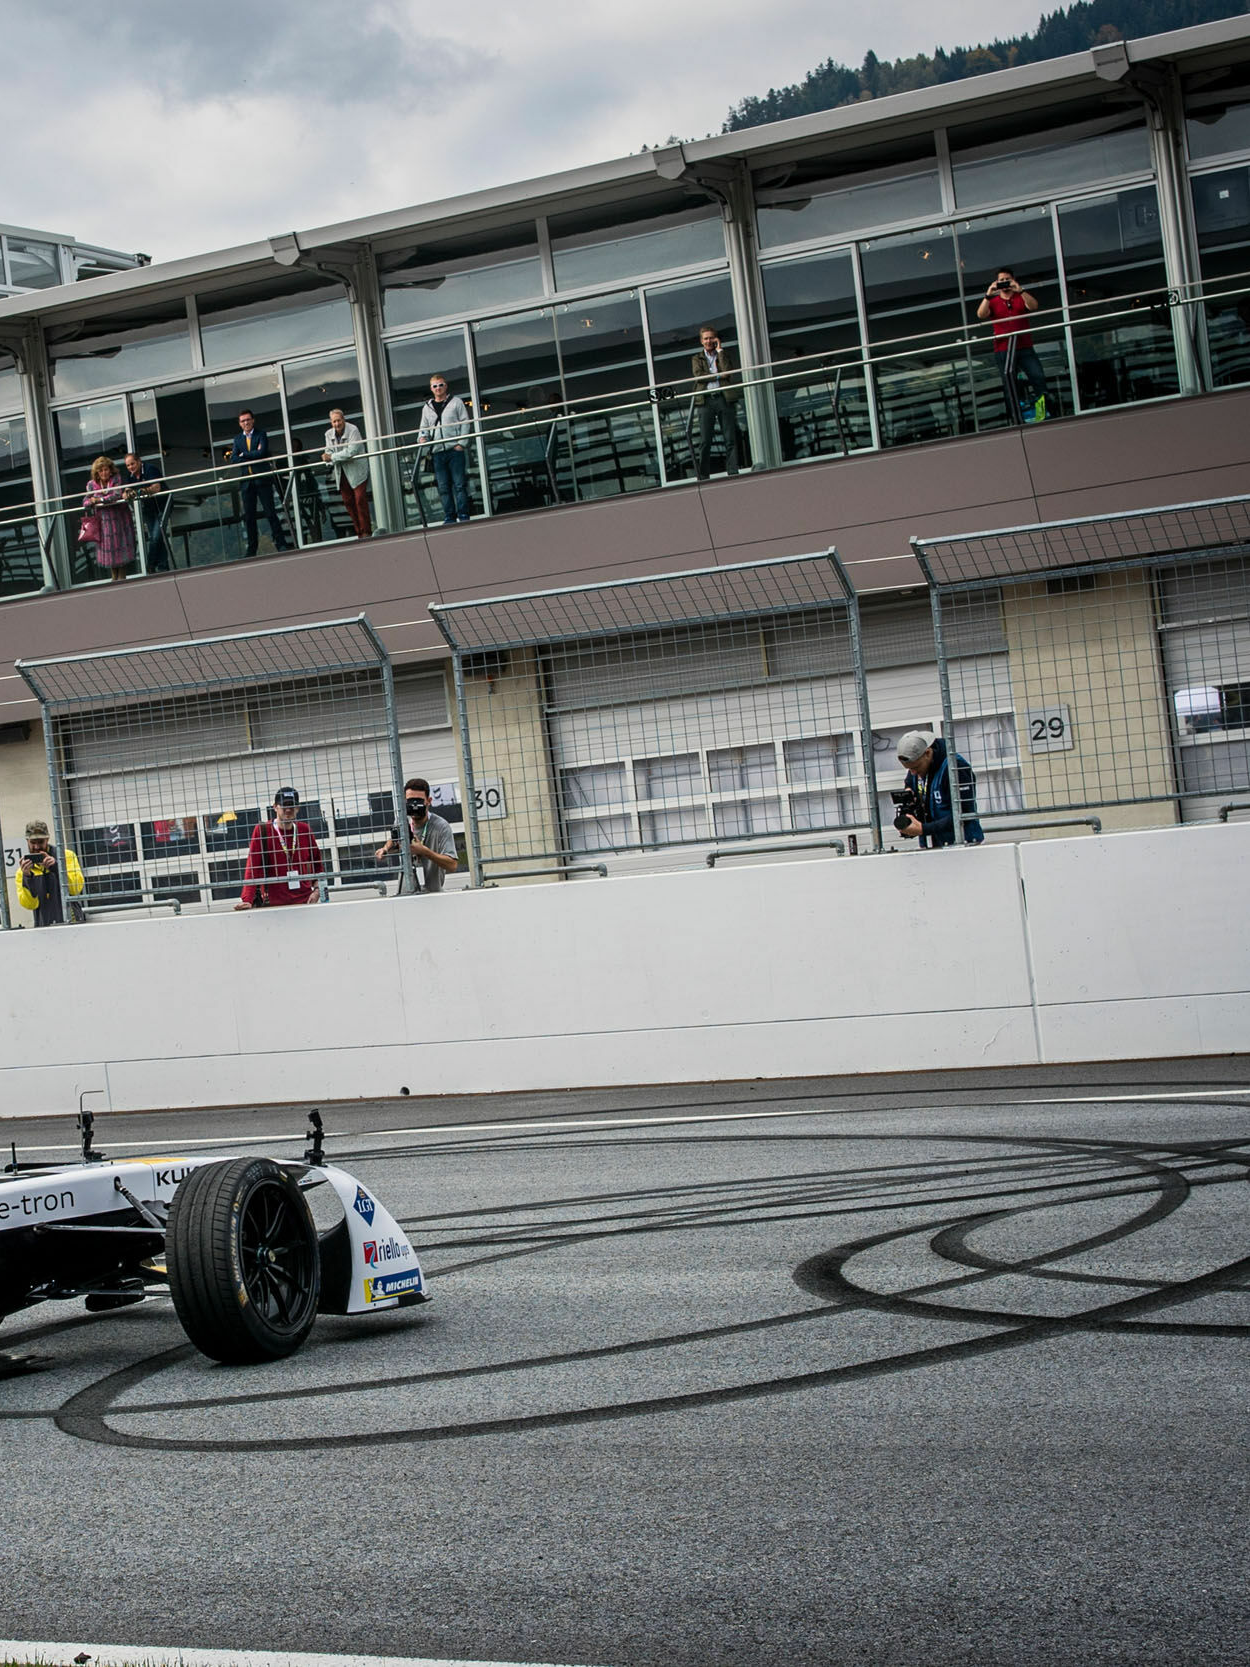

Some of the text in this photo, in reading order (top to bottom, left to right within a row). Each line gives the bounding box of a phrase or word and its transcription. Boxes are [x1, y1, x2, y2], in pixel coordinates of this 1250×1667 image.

[1031, 717, 1065, 741] 29
[474, 788, 500, 810] 30
[378, 1237, 401, 1262] riello
[385, 1276, 419, 1292] MICHELIN
